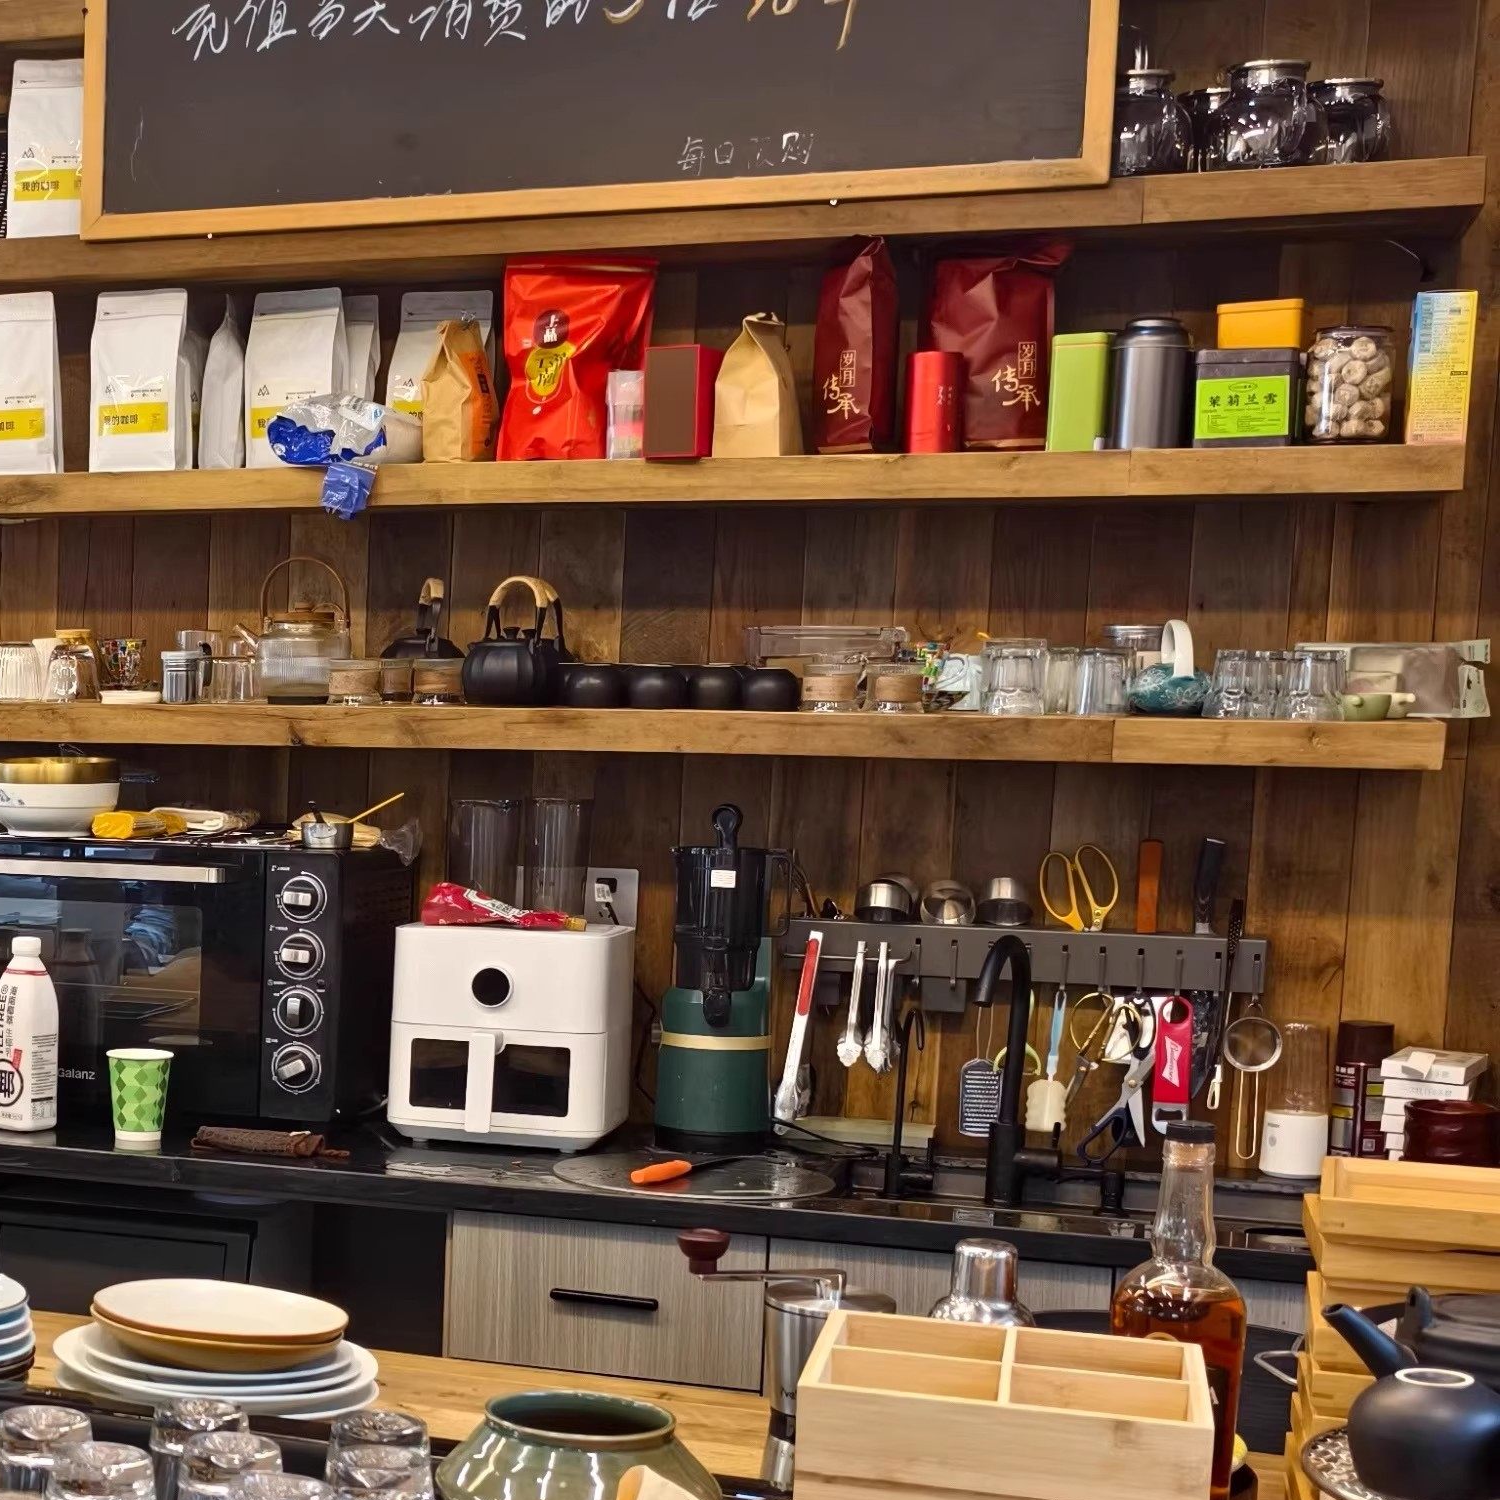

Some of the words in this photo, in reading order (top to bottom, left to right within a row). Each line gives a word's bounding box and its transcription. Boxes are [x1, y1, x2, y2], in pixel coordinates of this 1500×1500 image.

[823, 374, 860, 420] 传承
[991, 365, 1041, 412] 传承
[58, 1068, 95, 1080] Galanz
